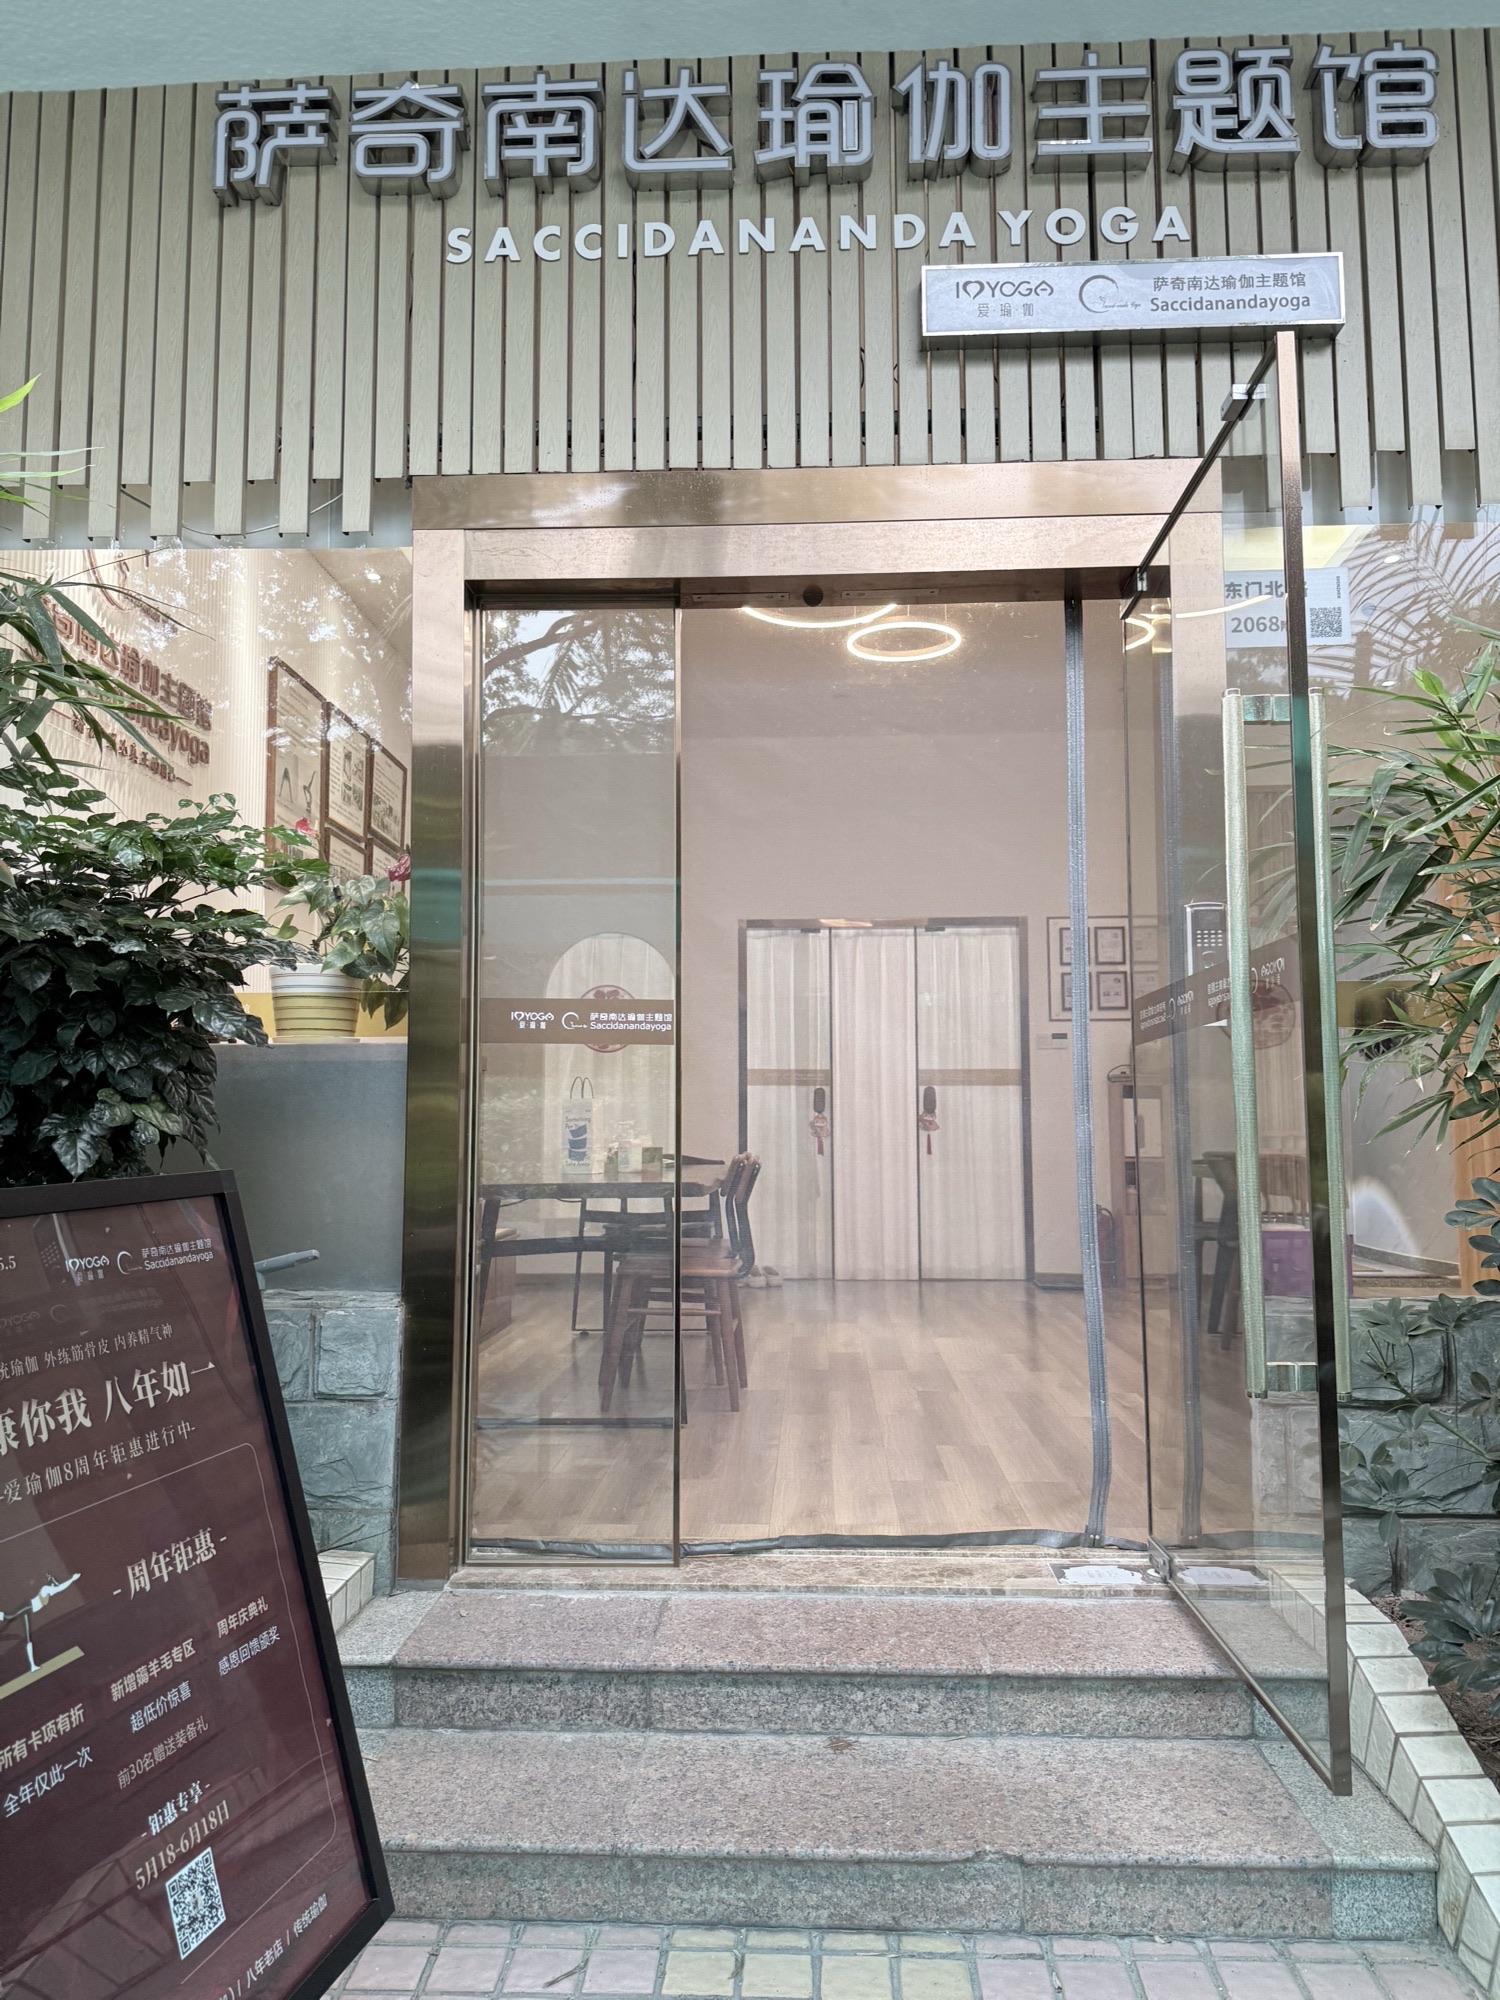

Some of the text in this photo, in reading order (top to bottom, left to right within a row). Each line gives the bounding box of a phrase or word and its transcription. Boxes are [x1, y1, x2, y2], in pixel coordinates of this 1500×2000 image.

[212, 40, 1440, 194] 萨奇南达瑜伽主题馆
[1150, 293, 1311, 313] Saccidanandayoga
[1152, 273, 1307, 292] 萨奇南达瑜伽主题馆
[1225, 580, 1309, 600] 东门北
[589, 1022, 672, 1032] Saccidanandayoga
[144, 1251, 214, 1271] Saccidanandayoga
[44, 1338, 110, 1369] 外练筋骨皮
[114, 1322, 173, 1352] 内养精气神
[104, 1361, 215, 1423] 八年如一
[217, 1595, 269, 1638] 周年庆典礼
[130, 1680, 192, 1733] 超低价惊喜
[117, 1715, 209, 1789] 前30名赠送装备礼
[3, 1746, 93, 1818] 全年仅此一次
[135, 1799, 230, 1890] 5月18-6月18日
